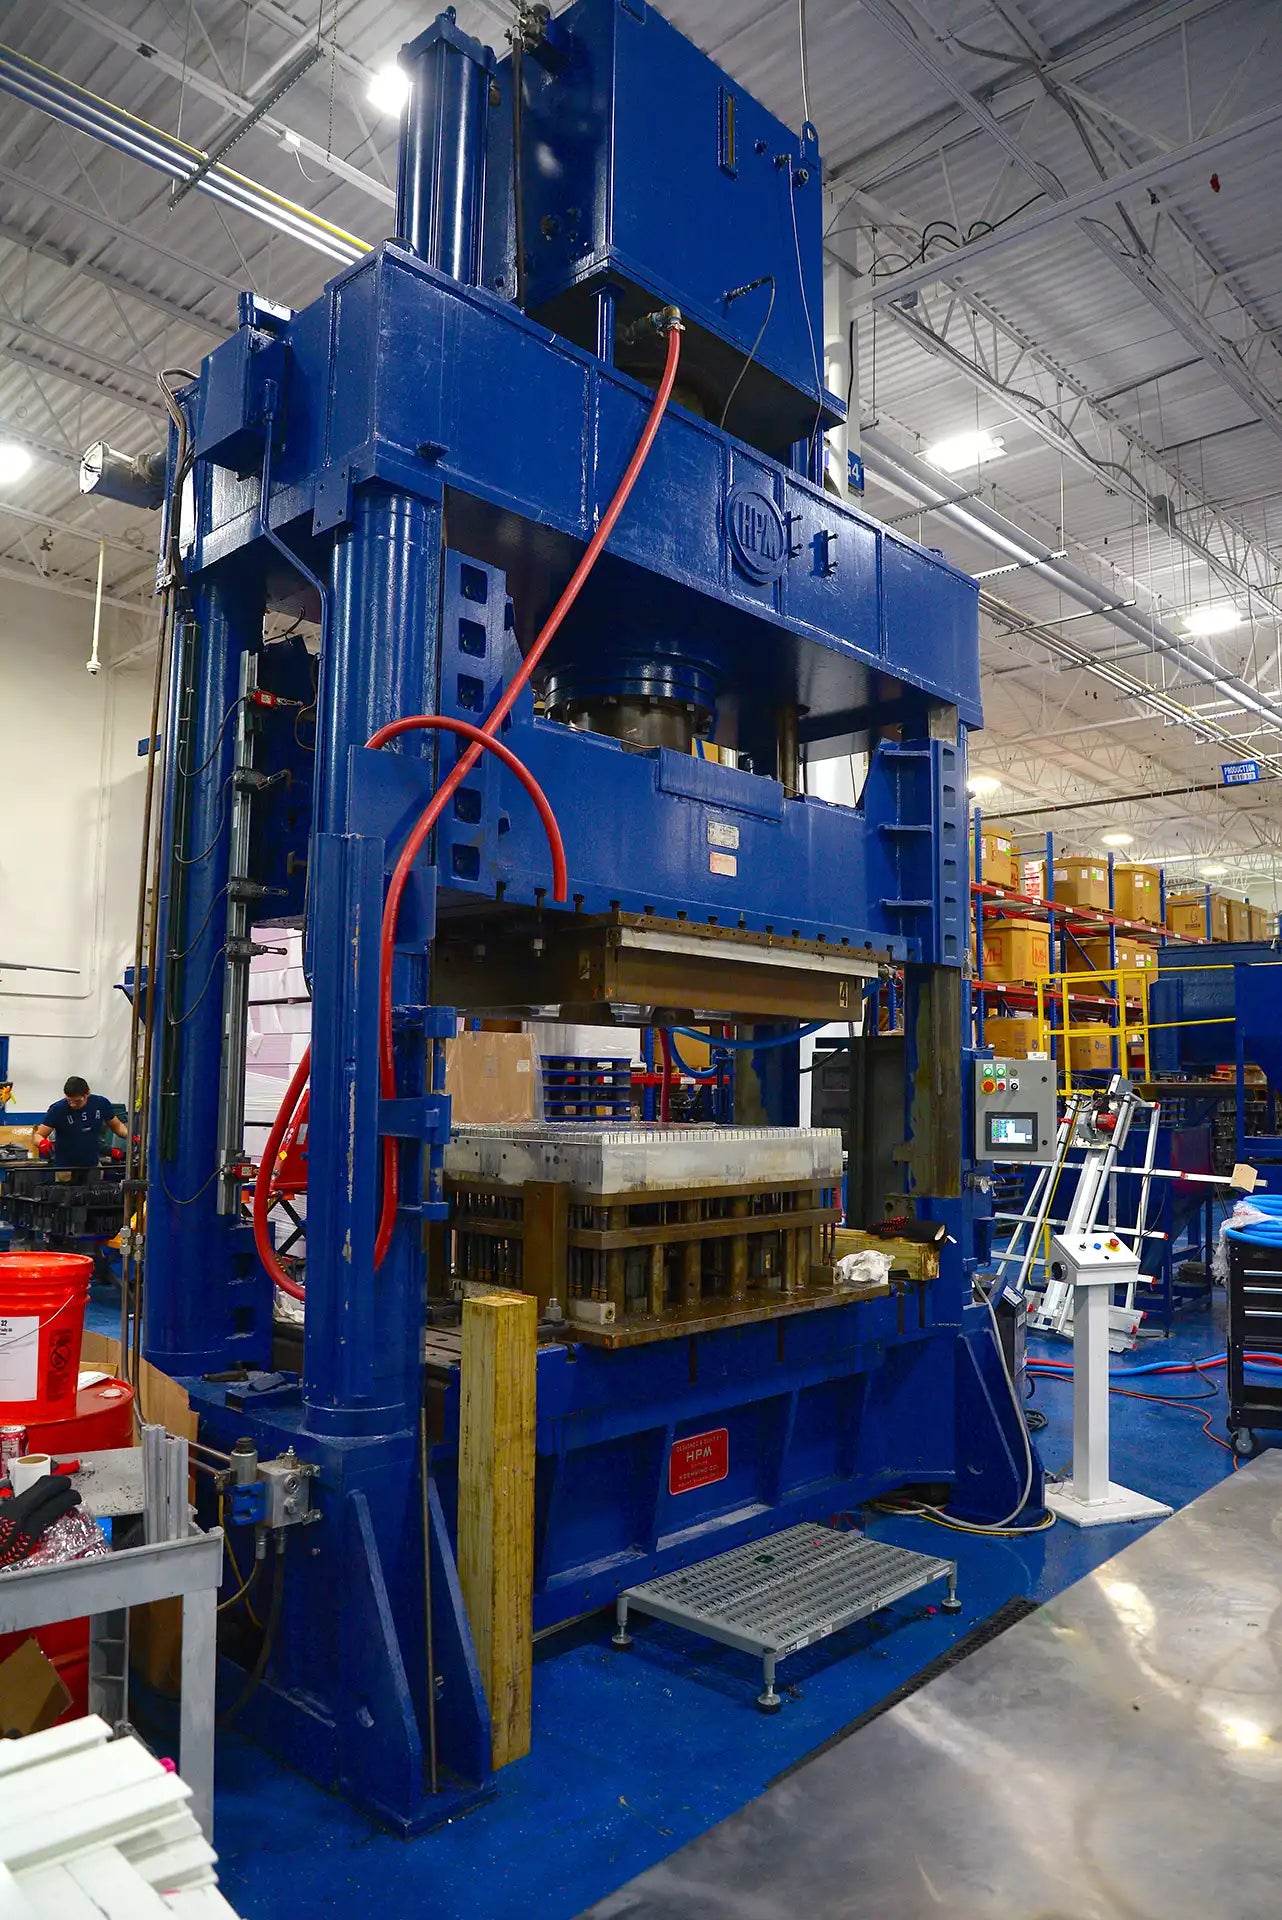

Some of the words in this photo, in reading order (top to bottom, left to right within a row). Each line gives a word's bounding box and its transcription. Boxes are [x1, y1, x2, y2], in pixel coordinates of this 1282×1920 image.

[734, 500, 780, 561] HPM
[1224, 764, 1256, 775] PRODUCTION
[840, 982, 847, 1006] 4
[686, 1446, 712, 1462] HPM
